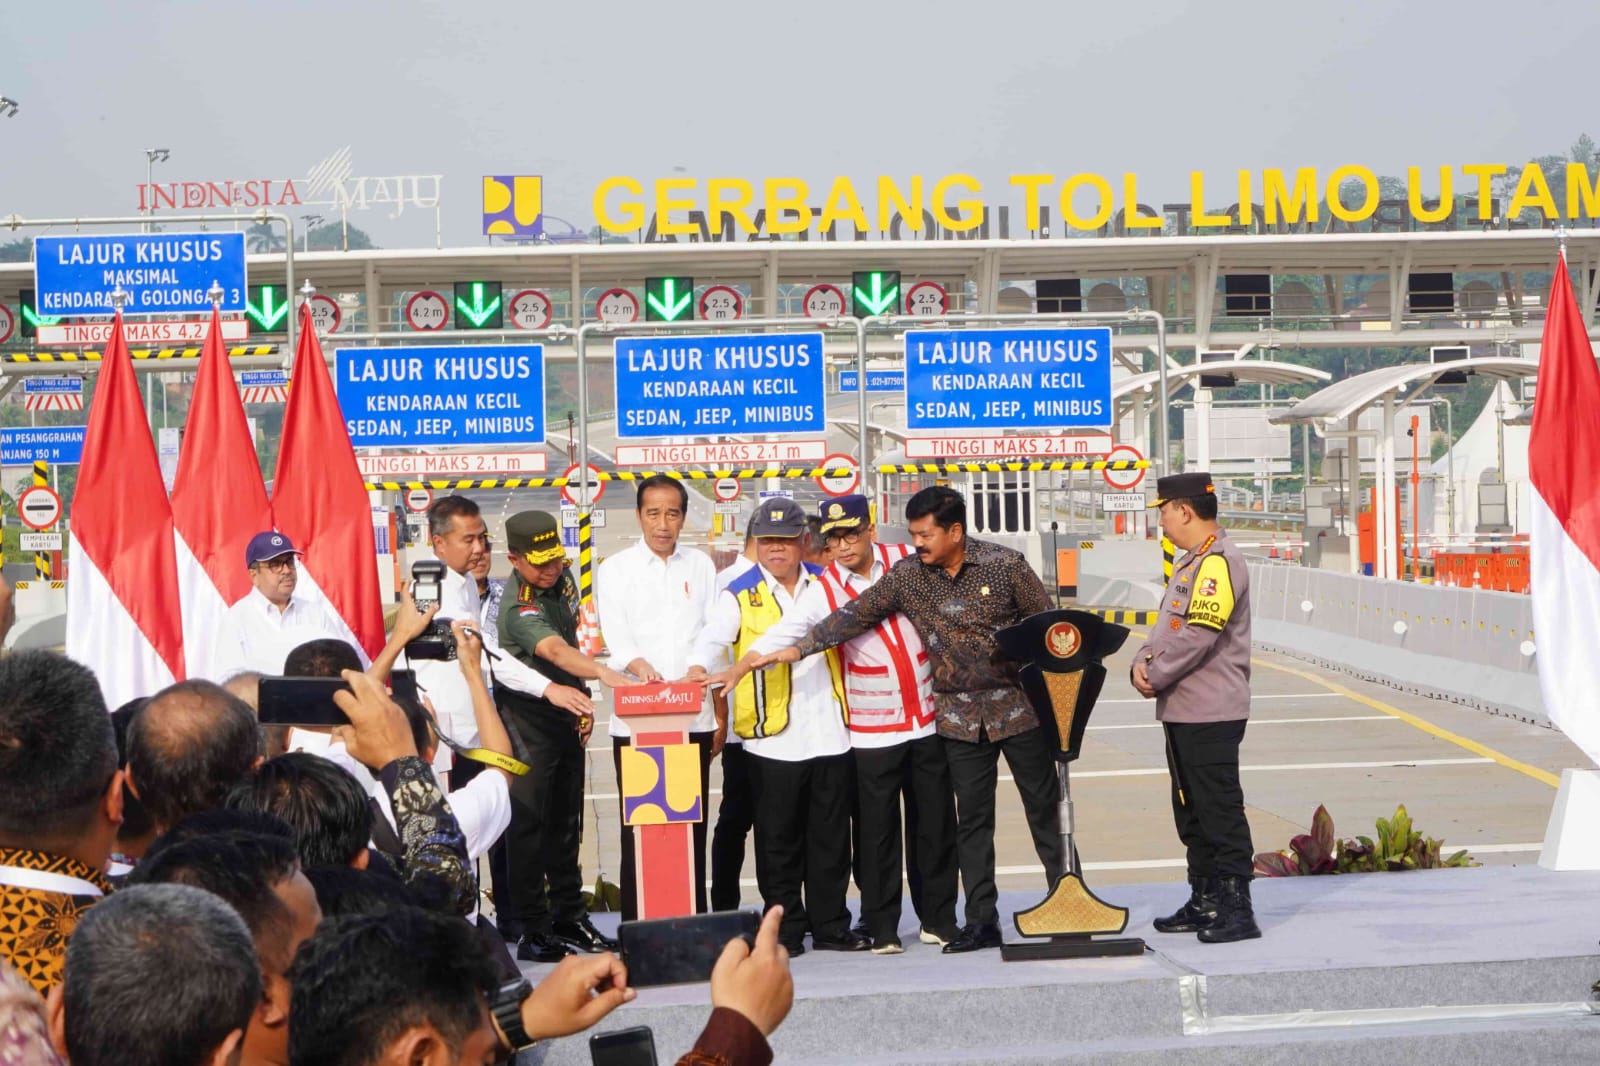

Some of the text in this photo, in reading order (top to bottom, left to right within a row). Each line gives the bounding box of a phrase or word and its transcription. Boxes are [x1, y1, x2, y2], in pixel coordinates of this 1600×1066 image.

[332, 174, 443, 219] MAJU
[593, 174, 984, 235] GERBANG
[1010, 173, 1164, 230] TOL
[1191, 165, 1380, 227] LIMO
[59, 240, 221, 264] LAJUR KHUSUS
[104, 269, 179, 285] MAKSIMAL
[44, 292, 134, 308] KENDARAN
[232, 289, 239, 303] 3
[711, 298, 730, 309] 2.5
[810, 300, 839, 311] 4.2 m
[918, 294, 936, 304] 2.5
[413, 307, 443, 318] 4.2 m
[521, 302, 539, 313] 2.5
[603, 304, 632, 315] 4.2 m
[715, 310, 726, 319] m
[921, 306, 932, 315] m
[525, 314, 536, 323] m
[64, 326, 111, 341] TINGG
[128, 325, 170, 340] MAKS
[629, 344, 809, 371] LAJUR KHUSUS
[919, 340, 1097, 363] LAJUR KHUSUS
[350, 357, 529, 381] LAJUR KHUSUS
[644, 379, 797, 397] KENDARAAN KECIL
[933, 373, 1084, 390] KENDARAAN KECIL
[367, 394, 520, 411] KENDARAAN KECIL
[916, 400, 1101, 419] SEDAN, JEEP, MINIBUS
[627, 406, 813, 426] SEDAN, JEEP, MINIBUS
[348, 416, 533, 437] SEDAN, JEEP, MINIBUS
[16, 432, 83, 443] PESANGGRAHAN
[35, 449, 49, 459] 150
[53, 448, 59, 458] M
[642, 448, 696, 463] TINGGI
[706, 446, 749, 461] MAKS
[787, 446, 800, 459] m
[932, 440, 985, 455] TINGGI
[994, 439, 1037, 454] MAKS
[1075, 439, 1088, 452] m
[362, 458, 416, 473] TINGGI
[426, 456, 469, 471] MAKS
[507, 457, 521, 470] m
[1191, 600, 1220, 613] PJKO
